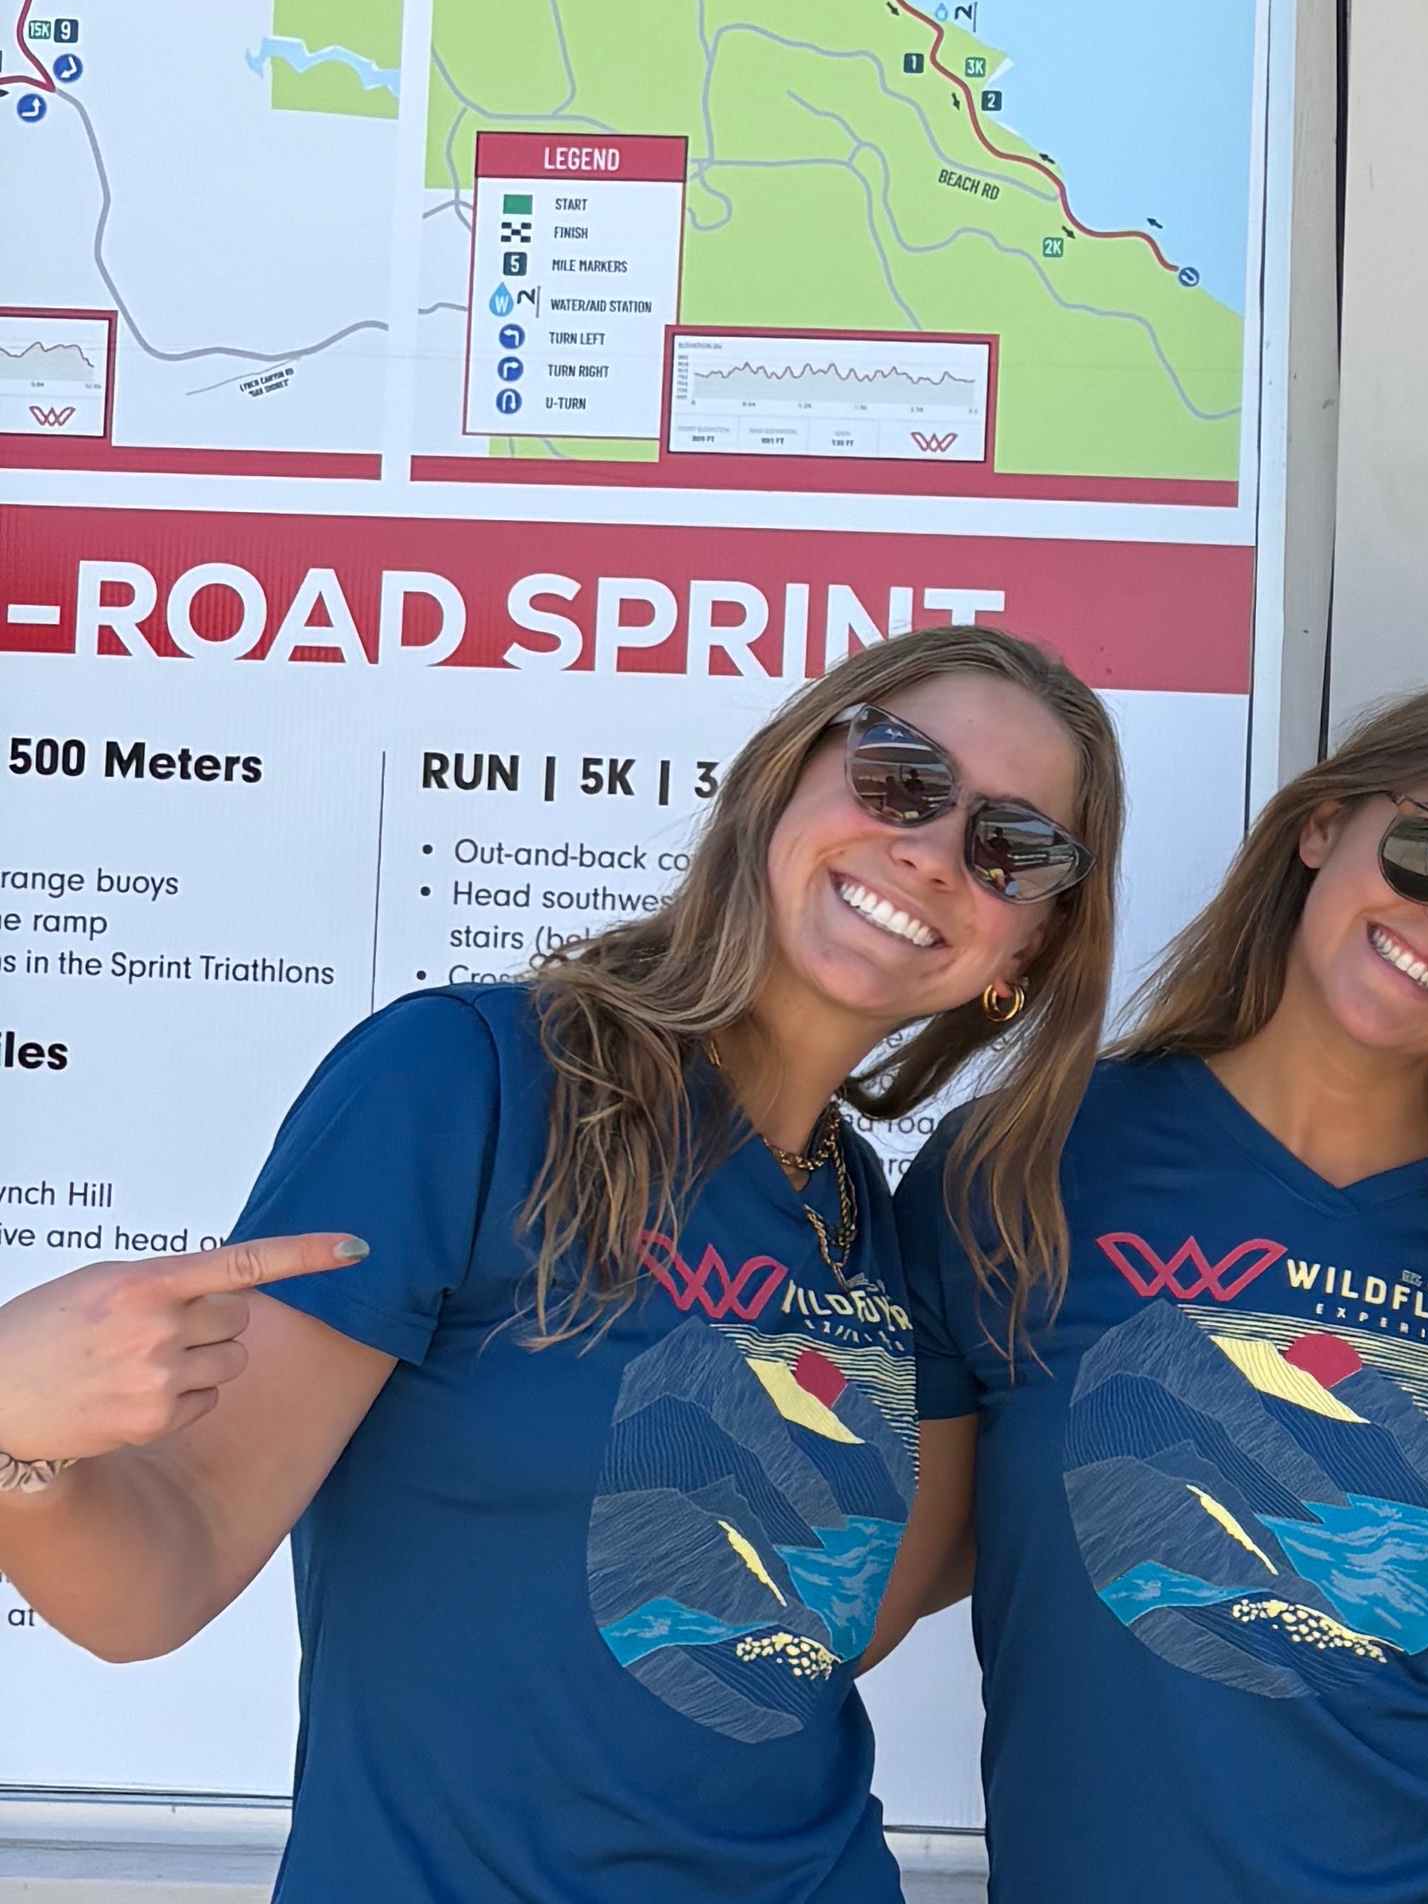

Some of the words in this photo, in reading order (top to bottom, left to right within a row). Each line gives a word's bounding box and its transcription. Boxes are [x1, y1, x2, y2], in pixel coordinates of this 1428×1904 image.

[545, 148, 619, 170] LEGEND
[9, 738, 85, 776] 500
[105, 741, 262, 783] Meters
[423, 752, 519, 791] RUN
[581, 758, 636, 795] 5K
[97, 868, 178, 901] buoys
[27, 956, 48, 973] in
[59, 951, 102, 975] the
[111, 952, 191, 984] Sprint
[200, 955, 333, 984] Triathlons
